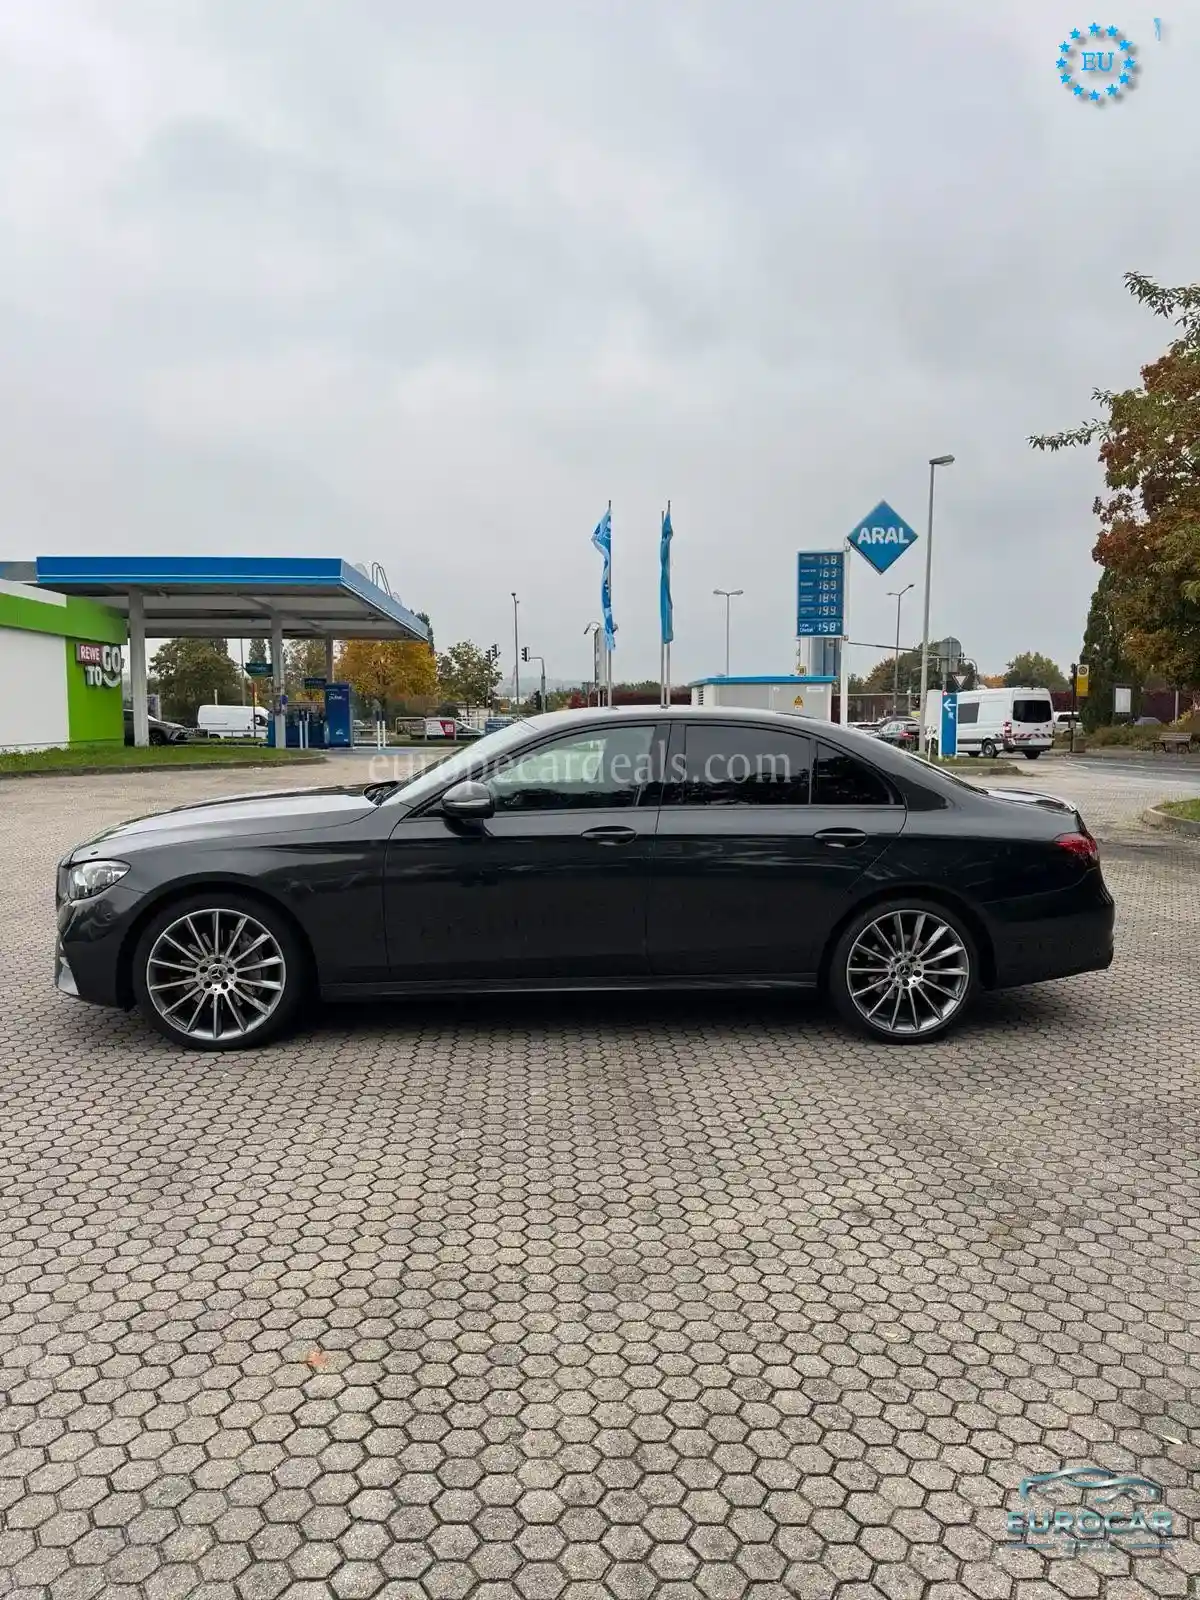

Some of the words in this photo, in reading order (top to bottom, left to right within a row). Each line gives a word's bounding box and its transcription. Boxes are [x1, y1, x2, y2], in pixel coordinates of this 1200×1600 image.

[857, 526, 910, 544] ARAL
[80, 645, 101, 661] REWE
[85, 665, 103, 686] TO
[102, 645, 122, 673] GO
